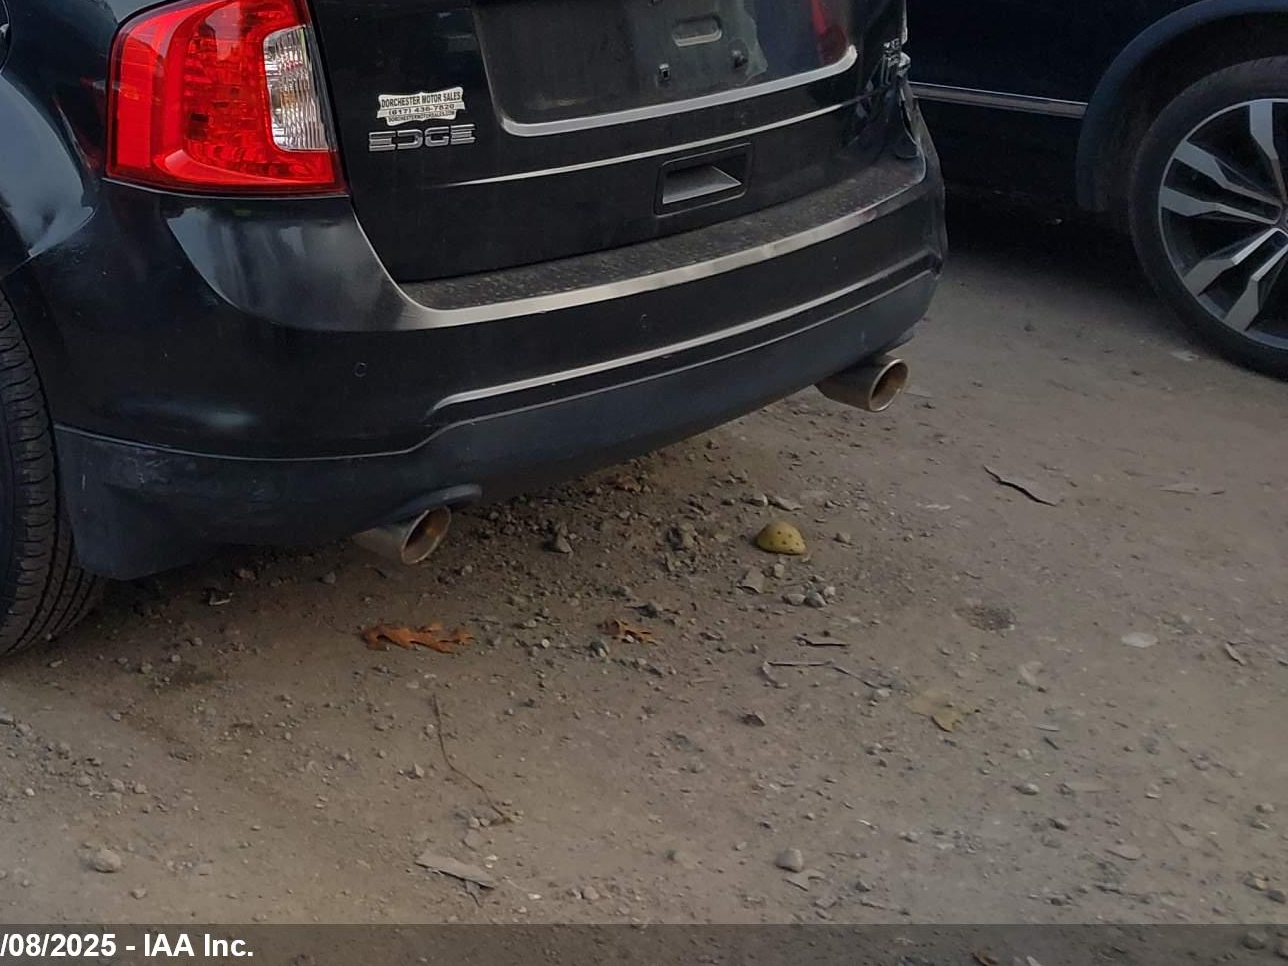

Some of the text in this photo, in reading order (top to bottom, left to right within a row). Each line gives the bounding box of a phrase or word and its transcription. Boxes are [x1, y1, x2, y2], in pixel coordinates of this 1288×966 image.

[381, 91, 461, 108] DORCHESTER MOTOR SALES
[388, 108, 412, 116] (617)
[369, 124, 476, 152] EDGE
